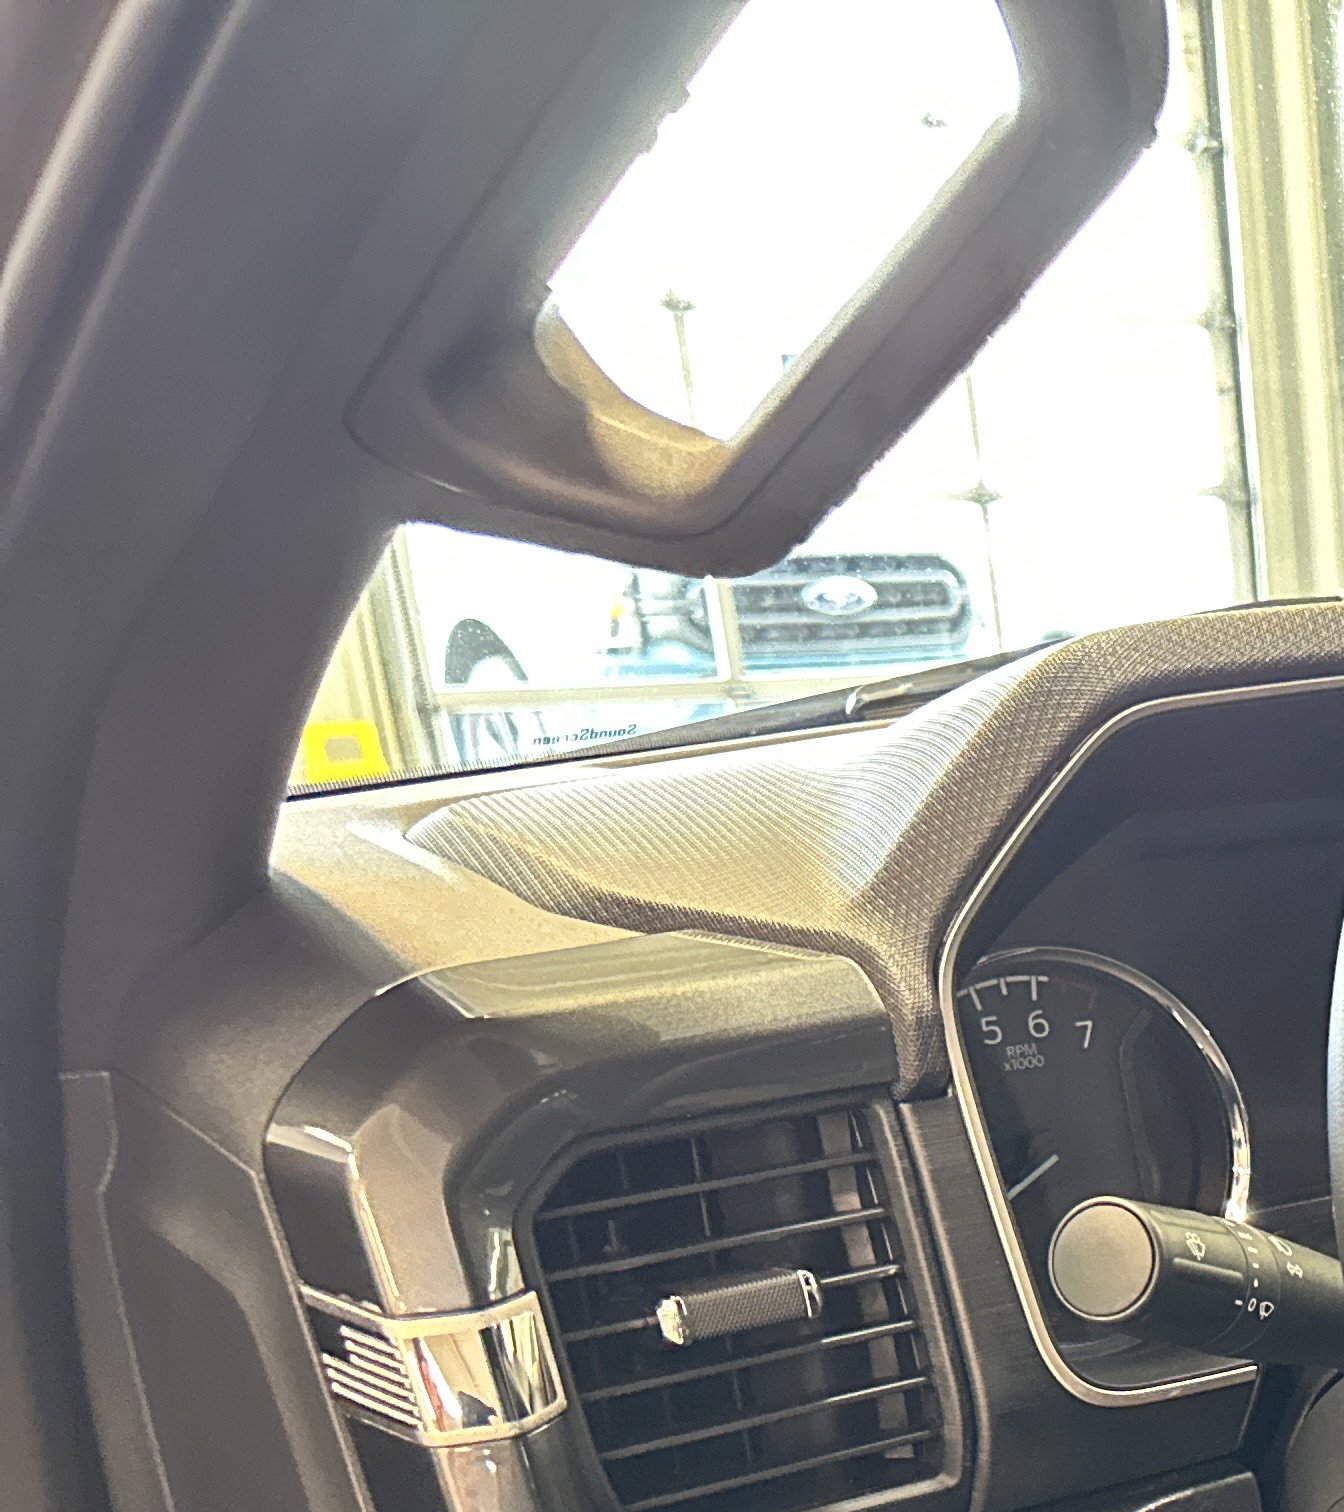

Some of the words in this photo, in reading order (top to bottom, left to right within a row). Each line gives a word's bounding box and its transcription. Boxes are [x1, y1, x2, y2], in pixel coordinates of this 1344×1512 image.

[981, 1016, 1003, 1045] 5
[1028, 1009, 1049, 1038] 6
[1074, 1020, 1093, 1048] 7
[1005, 1043, 1038, 1059] RPM
